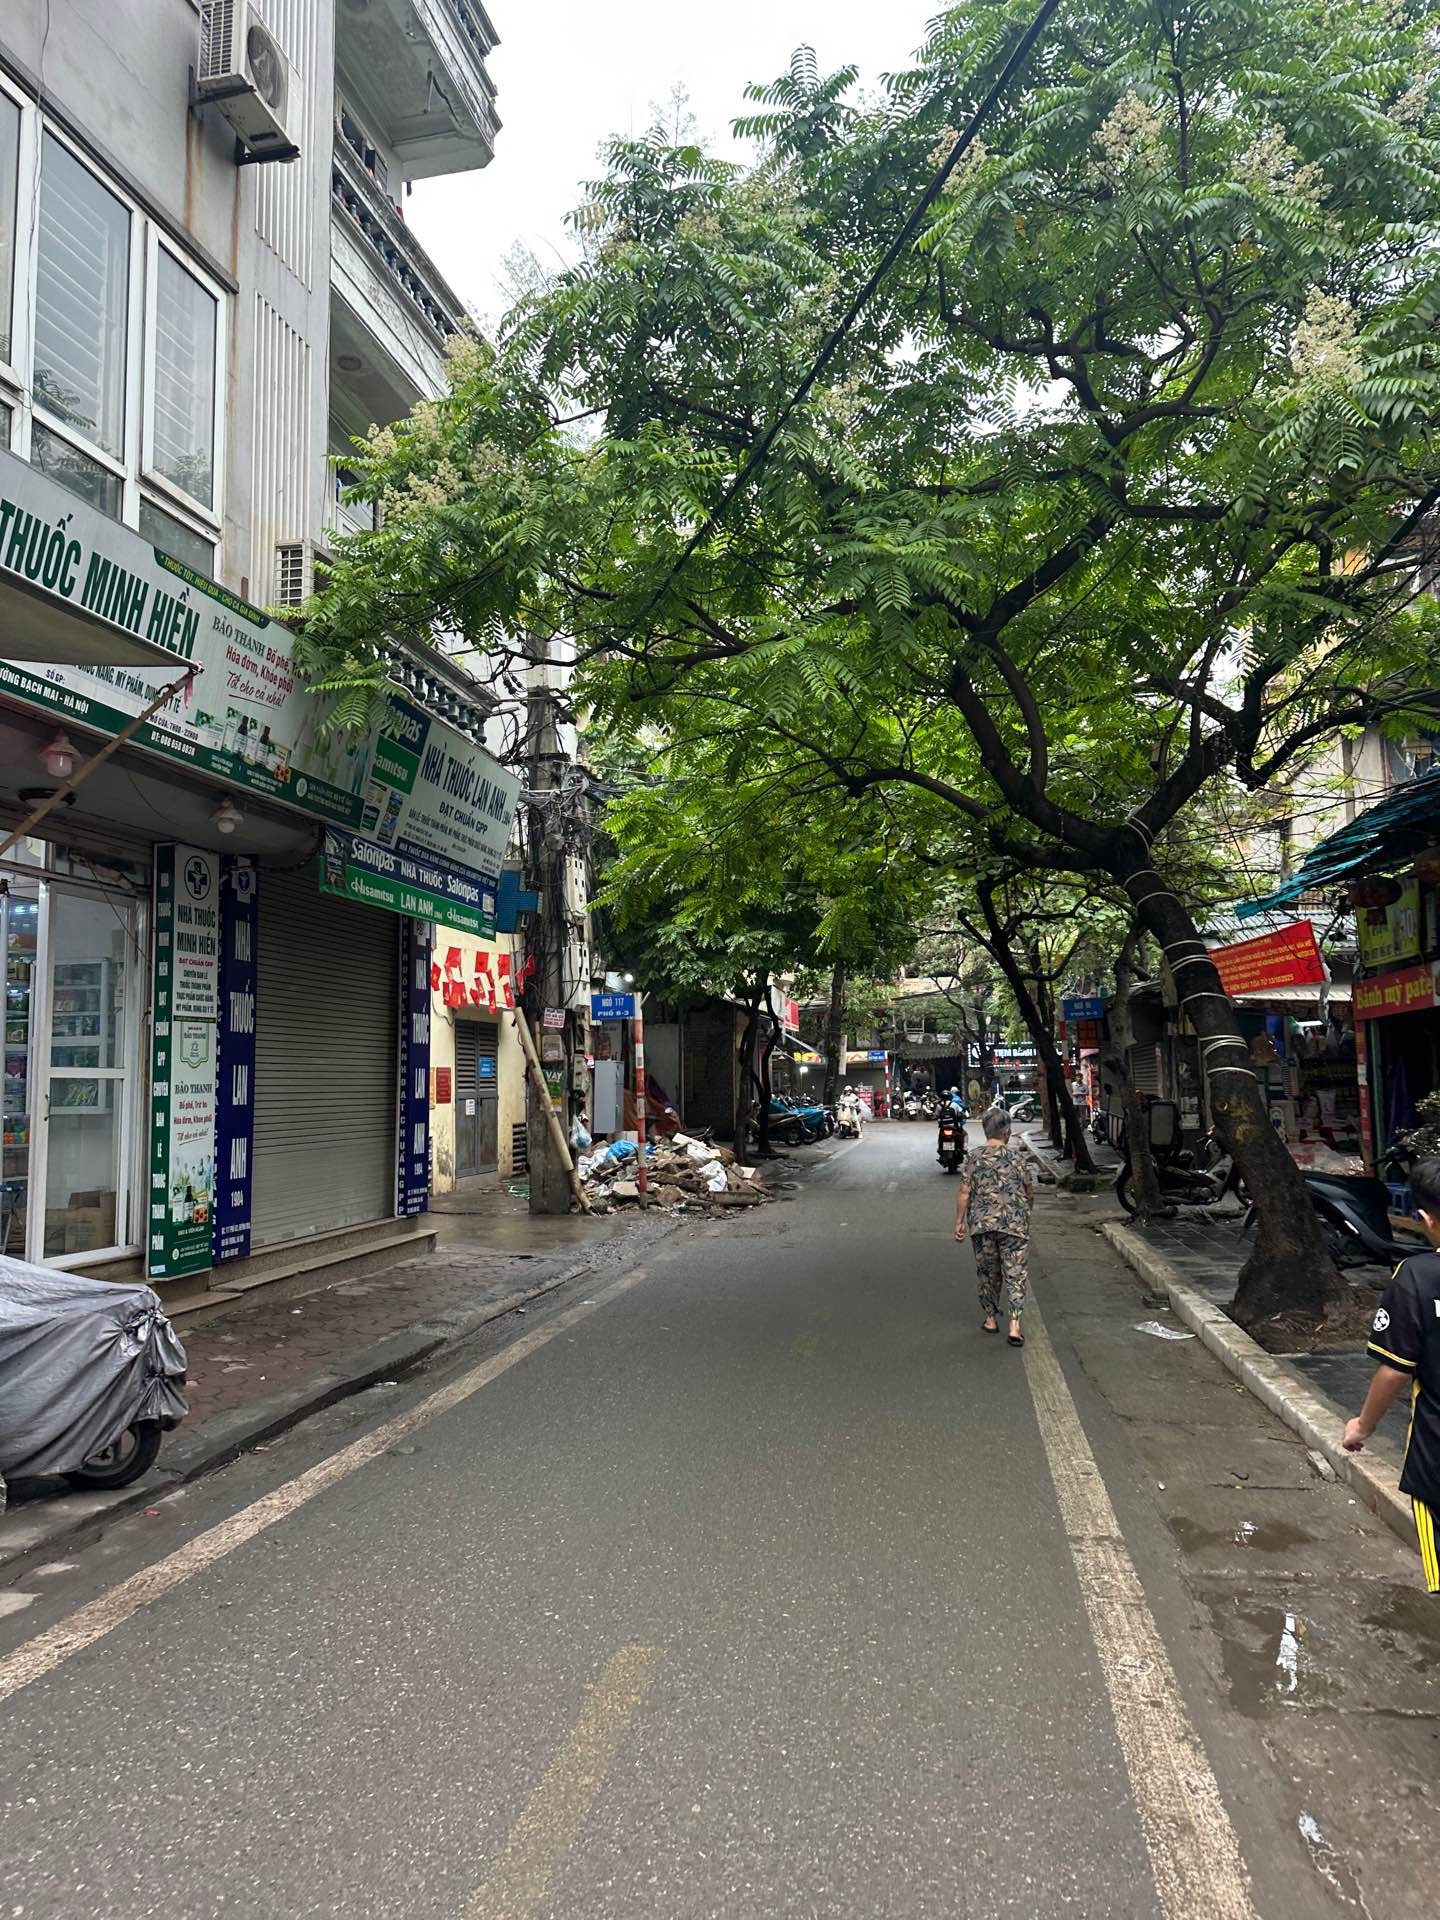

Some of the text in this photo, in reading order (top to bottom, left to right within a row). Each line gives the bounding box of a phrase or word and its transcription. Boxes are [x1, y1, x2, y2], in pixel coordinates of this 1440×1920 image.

[0, 498, 200, 659] THUỐC MINH HIỀN
[235, 628, 265, 658] THANH
[20, 677, 43, 694] BẠCH
[43, 686, 59, 701] MAI
[64, 693, 74, 708] HÀ
[74, 699, 89, 715] NỘI
[421, 742, 447, 786] NHÀ
[443, 756, 475, 801] THUỐC
[472, 774, 492, 812] LAN
[488, 783, 507, 821] ANH
[351, 838, 395, 872] Salonpas
[401, 861, 416, 880] NHÀ
[419, 867, 443, 889] THUỐC
[447, 875, 479, 902] Salonpas
[178, 902, 215, 928] NHÀ THUỐC
[351, 877, 394, 904] Hisamitsu
[401, 892, 417, 911] LAN
[417, 898, 434, 916] ANH
[447, 908, 479, 929] Hisamitsu
[177, 932, 197, 953] MINH
[230, 979, 254, 1034] THUỐC
[615, 998, 624, 1006] 117
[175, 1081, 212, 1094] BẢO THANH
[233, 1065, 248, 1105] LAN
[546, 1071, 562, 1080] VAY
[230, 1138, 247, 1180] ANH
